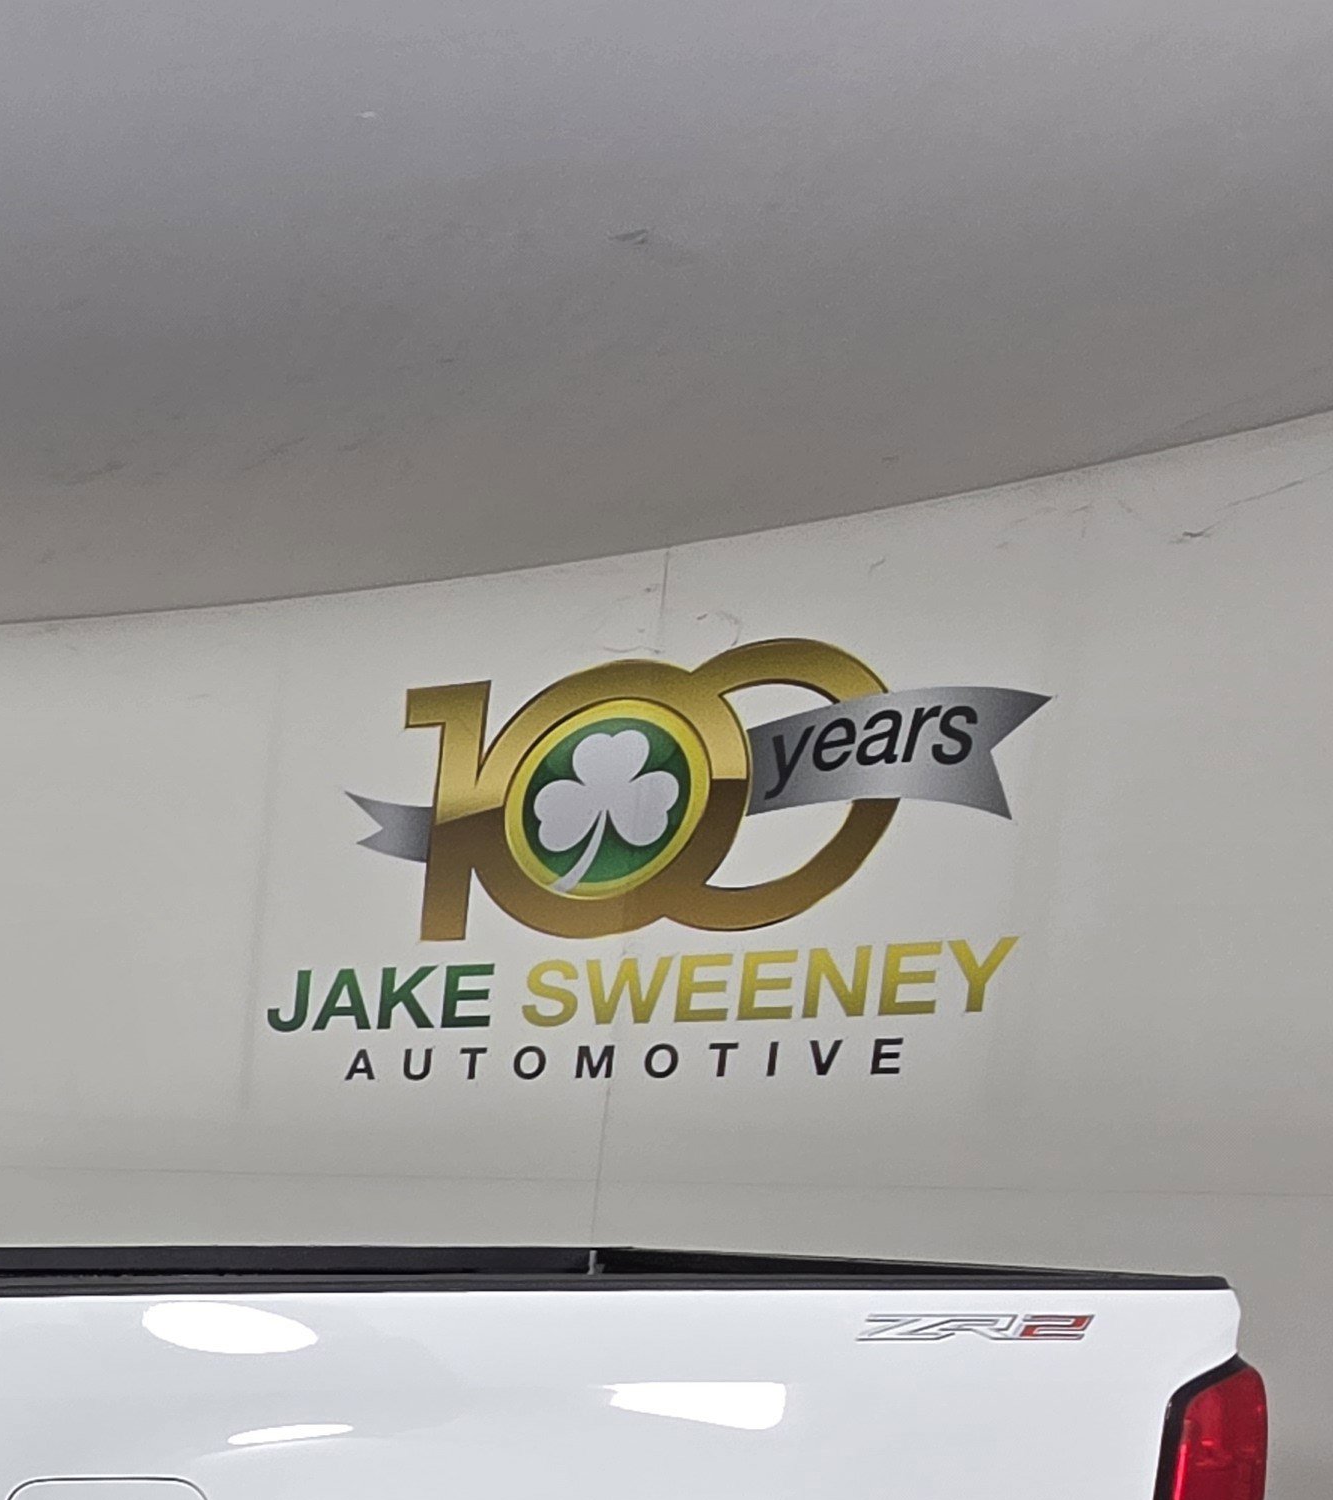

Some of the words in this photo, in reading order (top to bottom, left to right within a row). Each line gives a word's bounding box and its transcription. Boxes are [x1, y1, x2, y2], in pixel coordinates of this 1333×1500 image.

[405, 637, 900, 942] 100
[764, 702, 978, 800] years
[267, 963, 495, 1032] JAKE
[522, 936, 1019, 1026] SWEENEY
[345, 1038, 904, 1081] AUTOMOTIVE
[856, 1313, 1095, 1341] ZR2
